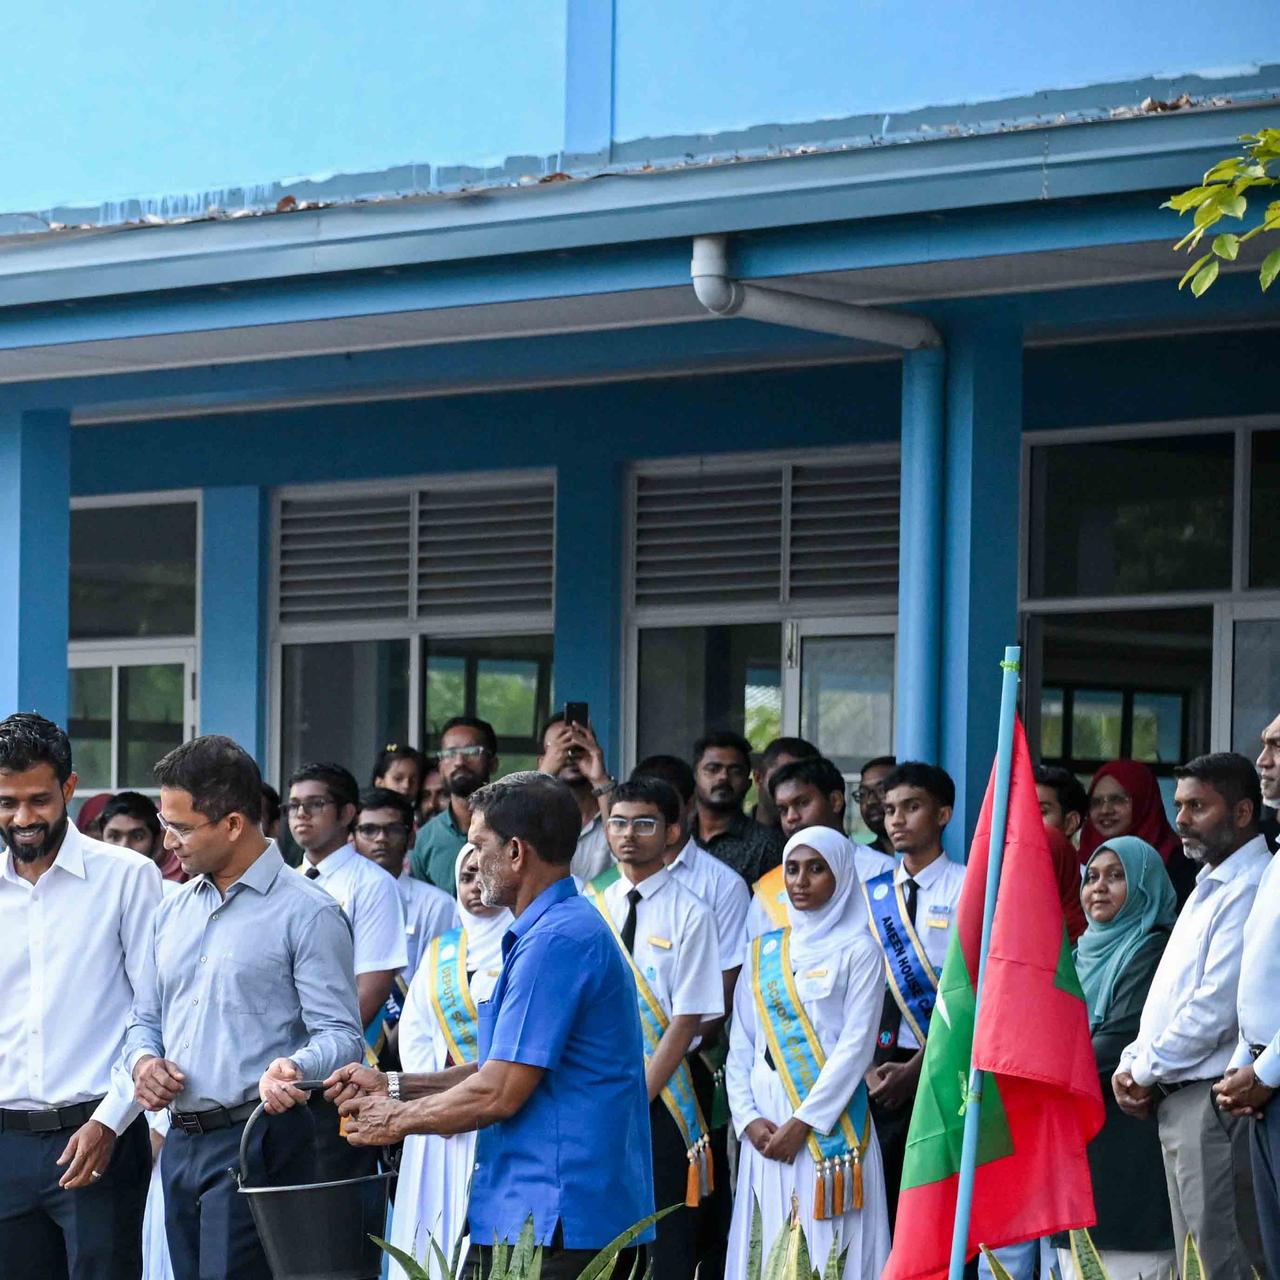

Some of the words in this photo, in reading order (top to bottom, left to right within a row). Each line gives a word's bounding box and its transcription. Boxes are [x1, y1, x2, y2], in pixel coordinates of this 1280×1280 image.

[881, 916, 906, 957] AMEEN
[897, 956, 923, 997] HOUSE
[766, 979, 793, 1037] SCHOOL
